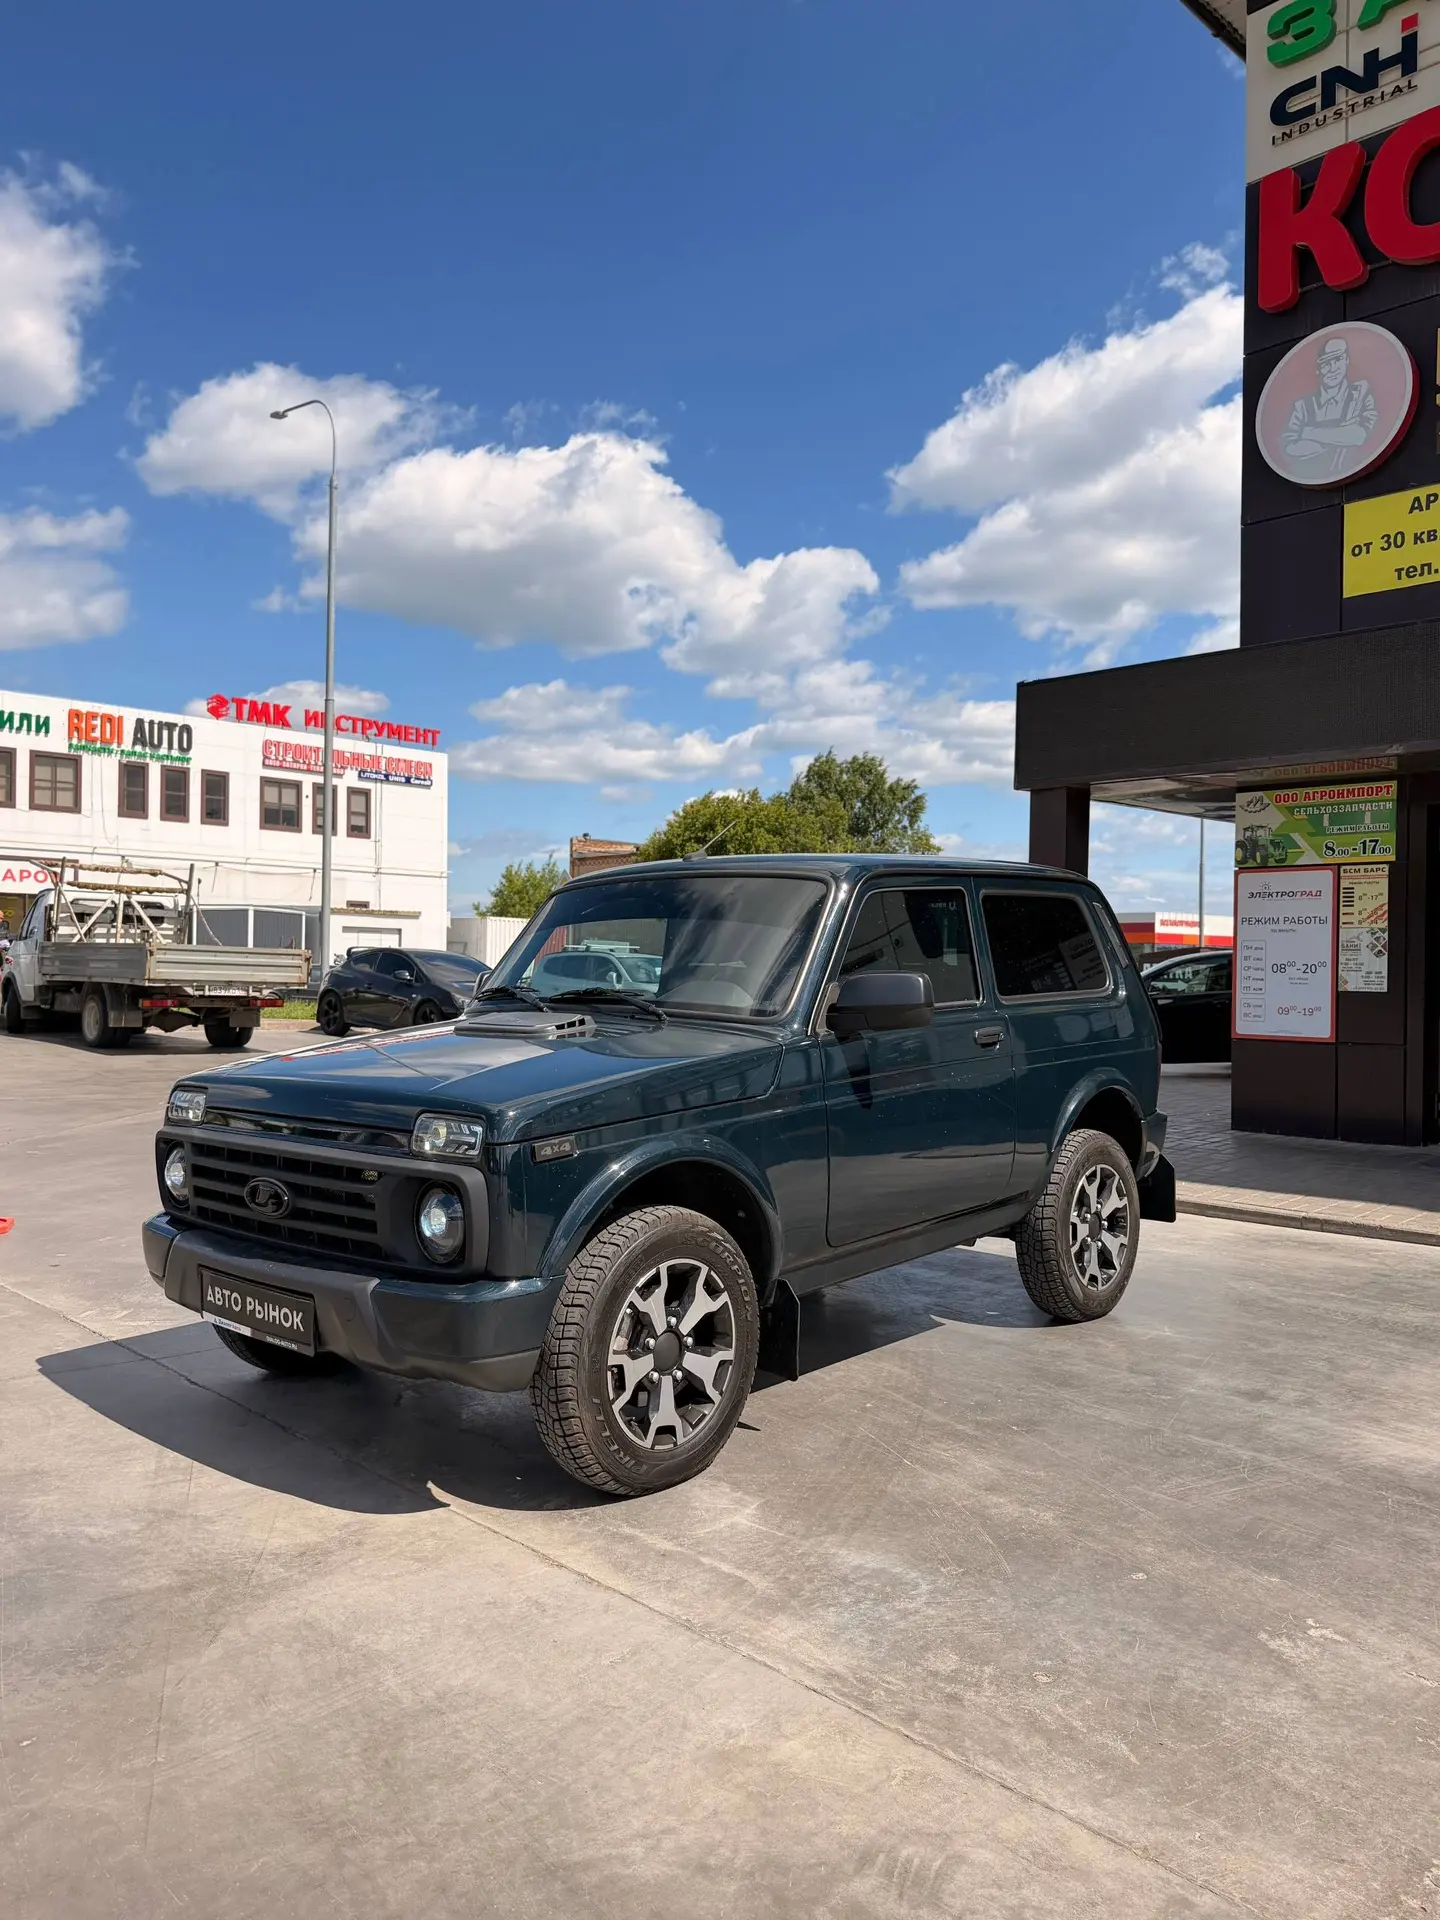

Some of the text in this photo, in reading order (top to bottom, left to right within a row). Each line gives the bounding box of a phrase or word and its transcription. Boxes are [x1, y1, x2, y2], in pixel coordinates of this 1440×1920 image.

[1269, 12, 1418, 127] CNH
[1271, 79, 1418, 147] INDUSTRIAL
[1350, 528, 1440, 558] от 30 кв
[1394, 561, 1439, 581] тел.
[232, 697, 292, 728] ТМК
[68, 708, 193, 753] REDI AUTO
[263, 739, 432, 777] СТРОИТЛЬНЫЕ СМЕСИ
[1274, 784, 1394, 804] ООО АГРОИМПОРТ
[1294, 801, 1393, 816] СЕЛЬХОЗЗАПЧАСТИ
[1326, 823, 1389, 834] РЕЖИМ РАБОТЫ
[1247, 890, 1322, 899] ЭЛЕКТРОГРАД
[1241, 915, 1328, 926] РЕЖИМ РАБОТЫ
[207, 1284, 305, 1332] АВТО РЫНОК
[591, 1396, 648, 1476] PIRELLI
